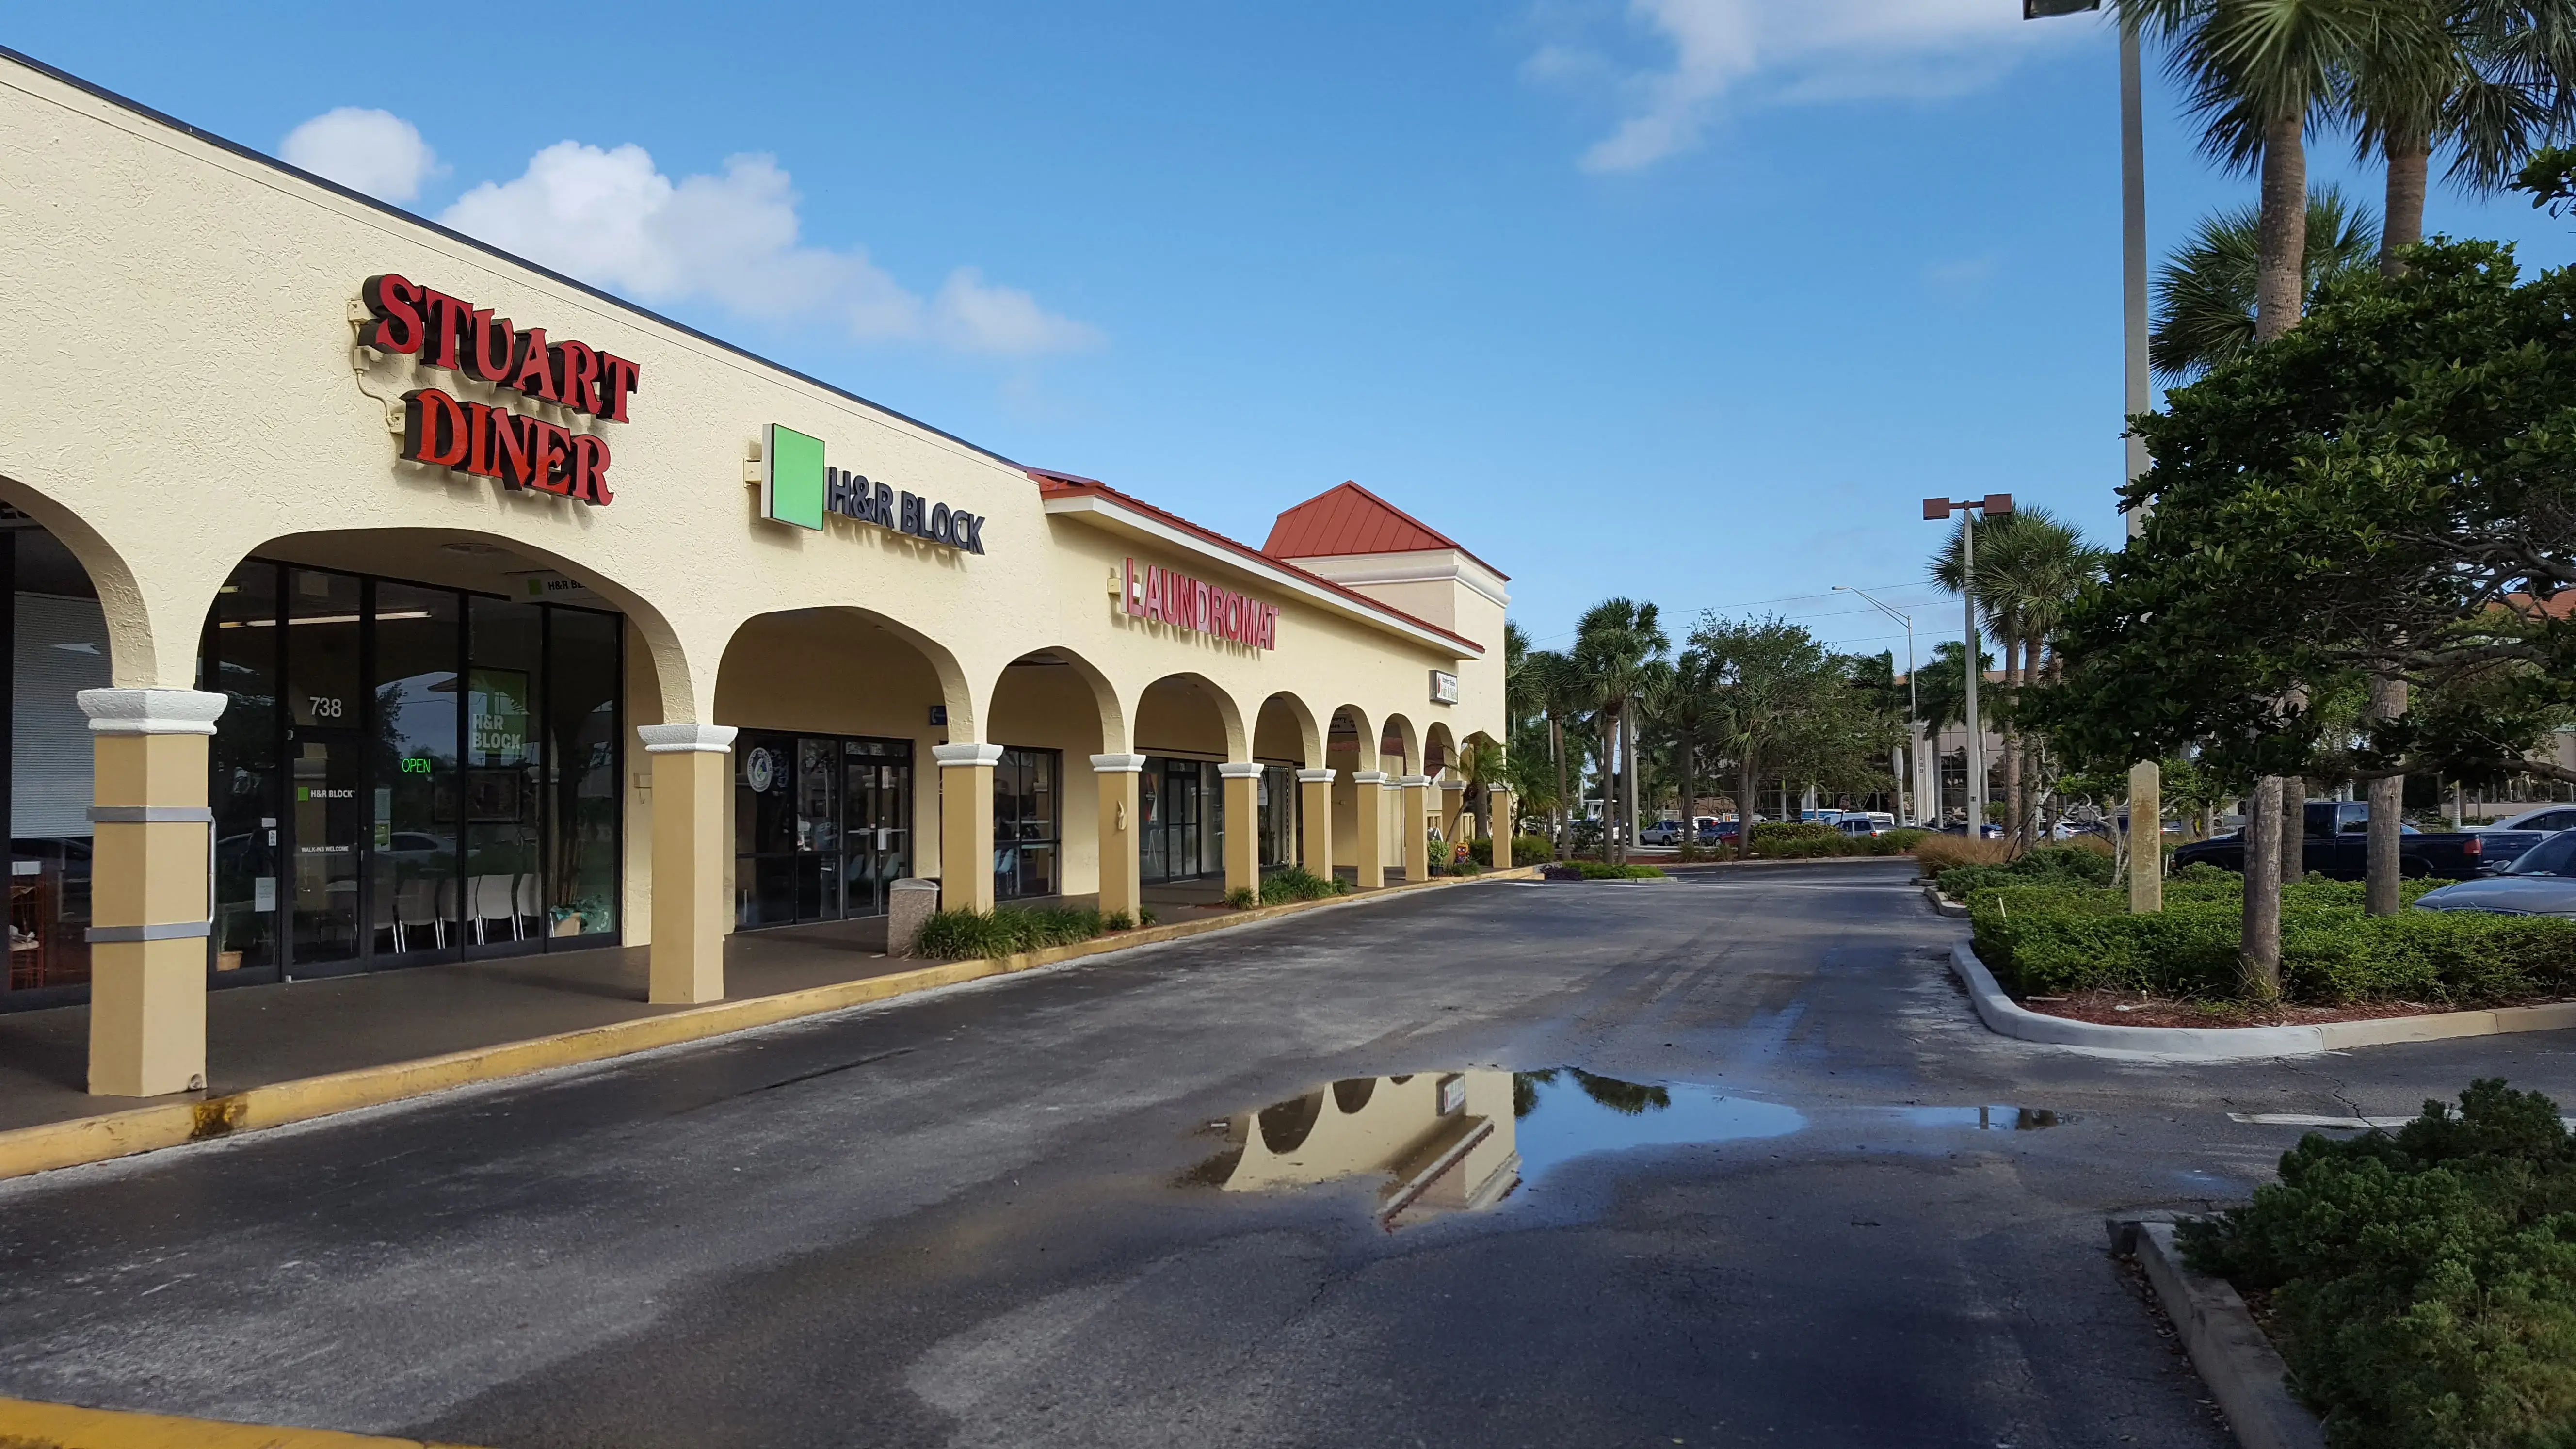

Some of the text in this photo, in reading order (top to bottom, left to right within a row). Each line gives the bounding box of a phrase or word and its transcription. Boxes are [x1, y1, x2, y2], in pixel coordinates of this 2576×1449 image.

[361, 274, 640, 423] STUART
[402, 388, 613, 505] DINER
[827, 467, 985, 555] H&R BLOCK
[548, 581, 569, 590] H&R
[1124, 558, 1279, 651] LAUNDROMAT
[310, 696, 342, 717] 738
[473, 713, 504, 730] H&R
[472, 732, 521, 749] BLOCK
[402, 758, 430, 773] OPEN
[329, 789, 353, 798] BLOCK
